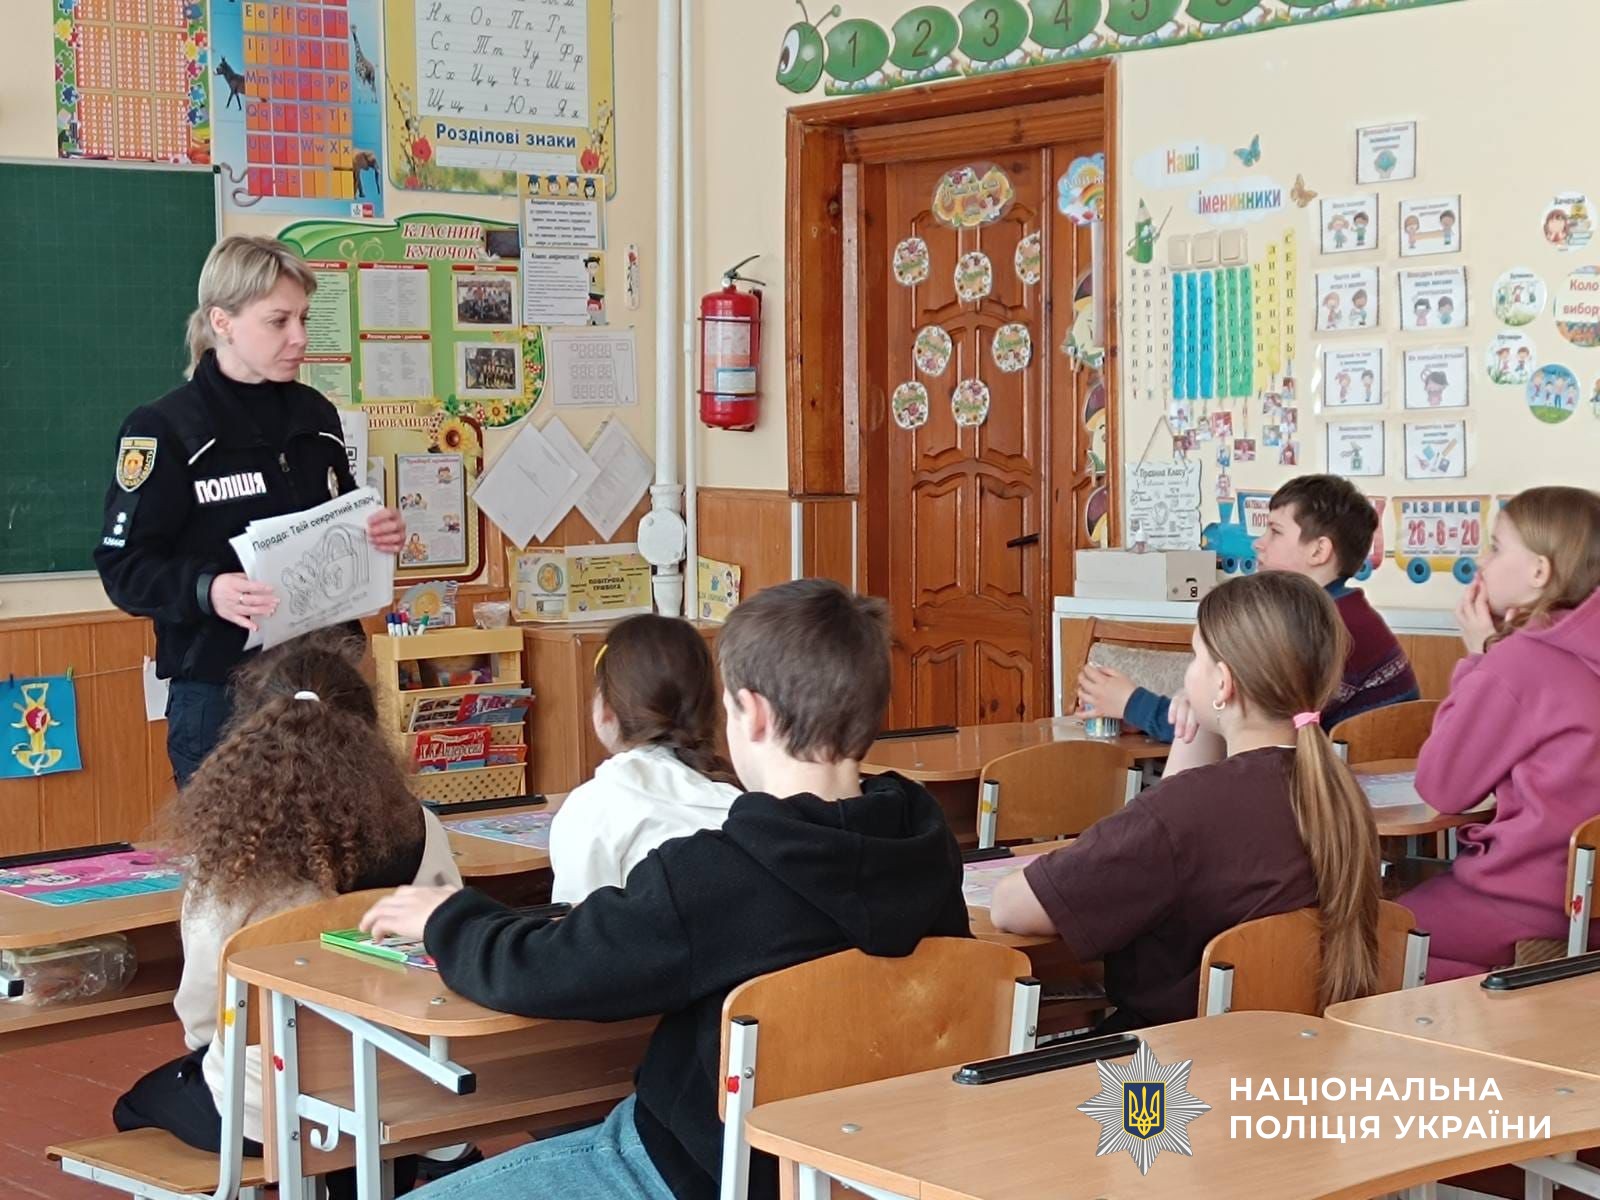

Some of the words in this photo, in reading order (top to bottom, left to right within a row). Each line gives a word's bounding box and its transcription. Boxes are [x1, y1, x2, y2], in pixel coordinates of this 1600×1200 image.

[845, 31, 858, 68] 1
[912, 20, 933, 57] 2
[982, 8, 1000, 47] 3
[1053, 0, 1072, 32] 4
[436, 122, 520, 145] Розділові
[526, 132, 576, 148] знаки
[1166, 146, 1200, 174] Наші
[1198, 188, 1281, 214] іменинники
[403, 223, 480, 239] КЛАСНИЙ
[406, 244, 479, 259] КУТОЧОК
[1570, 279, 1599, 290] Коло
[369, 417, 429, 428] НЮВАННЯ
[194, 471, 267, 504] ПОЛІЦІЯ
[1402, 501, 1480, 514] РІЗНИЦЯ
[252, 531, 289, 552] Порада:
[289, 520, 309, 536] Твій
[311, 501, 353, 527] секретний
[355, 495, 375, 509] ключ
[1408, 520, 1426, 546] 26
[1437, 520, 1446, 546] 6
[1461, 519, 1480, 546] 20
